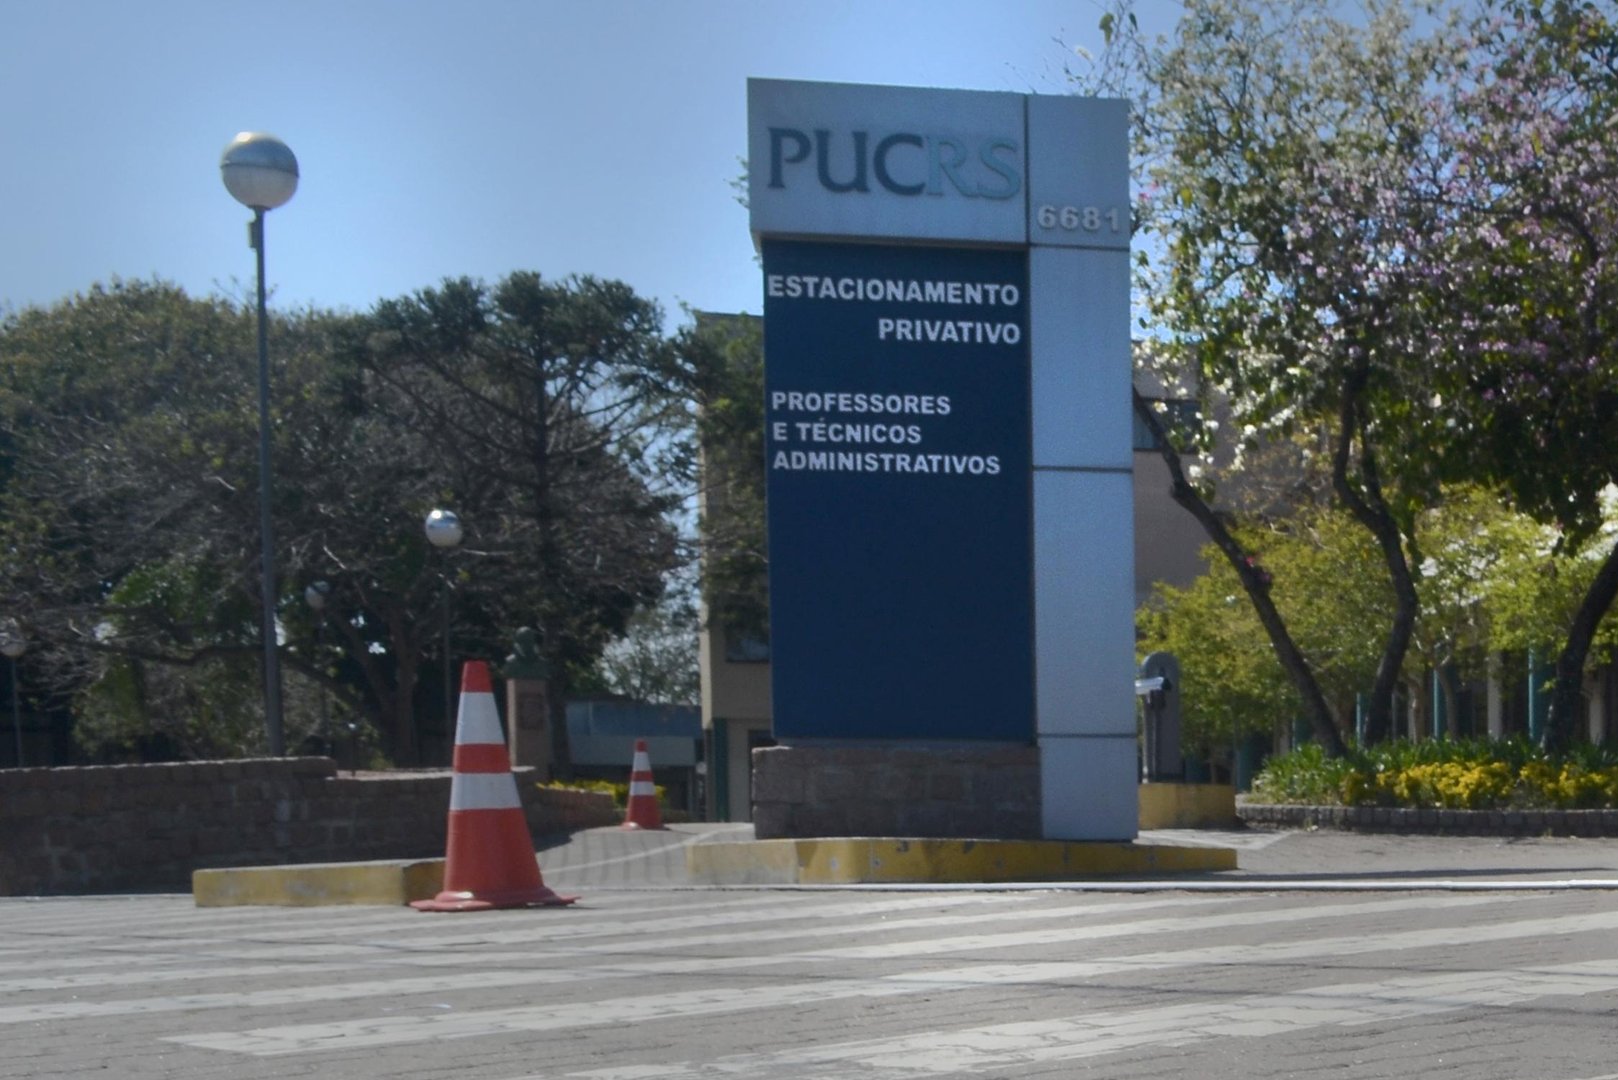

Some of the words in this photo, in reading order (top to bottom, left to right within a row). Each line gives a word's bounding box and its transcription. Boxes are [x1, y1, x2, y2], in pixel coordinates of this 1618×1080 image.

[767, 126, 1022, 200] PUCRS
[1037, 205, 1122, 232] 6681
[767, 275, 1019, 306] ESTACIONAMENTO
[878, 317, 1021, 345] PRIVATIVO
[771, 391, 951, 415] PROFESSORES
[773, 422, 787, 441] E
[796, 417, 921, 444] TÉCNICOS
[773, 452, 1001, 474] ADMINISTRATIVOS
